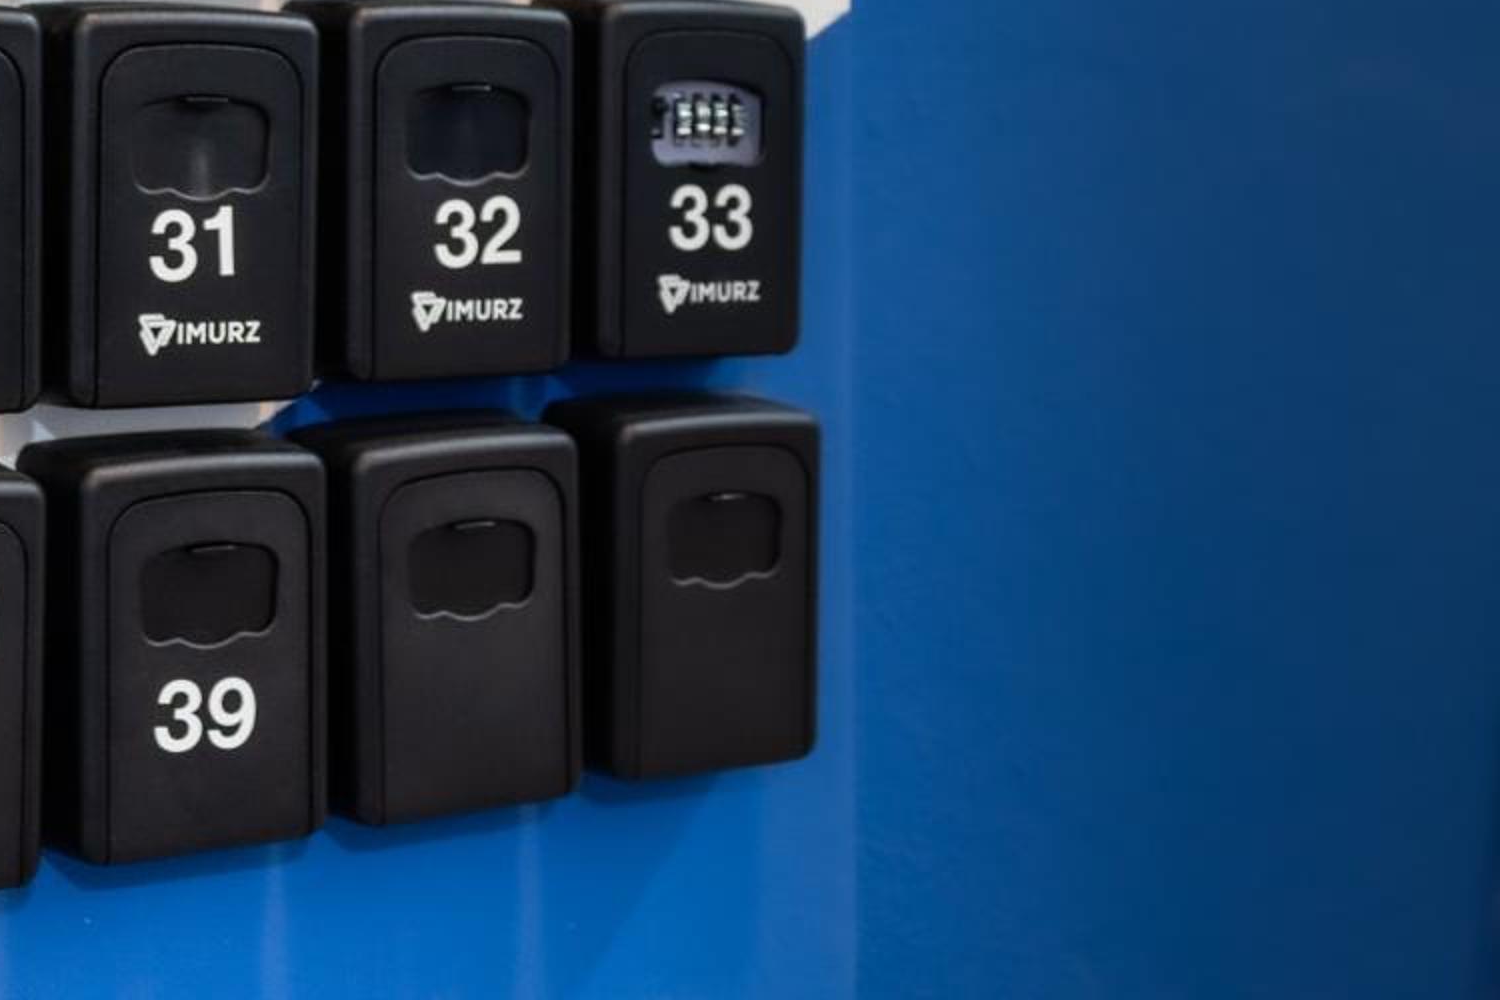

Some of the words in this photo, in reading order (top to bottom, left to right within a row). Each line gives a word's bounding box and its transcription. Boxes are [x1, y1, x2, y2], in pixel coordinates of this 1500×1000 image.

[150, 205, 234, 282] 31
[435, 195, 521, 268] 32
[670, 184, 752, 250] 33
[154, 677, 256, 752] 39
